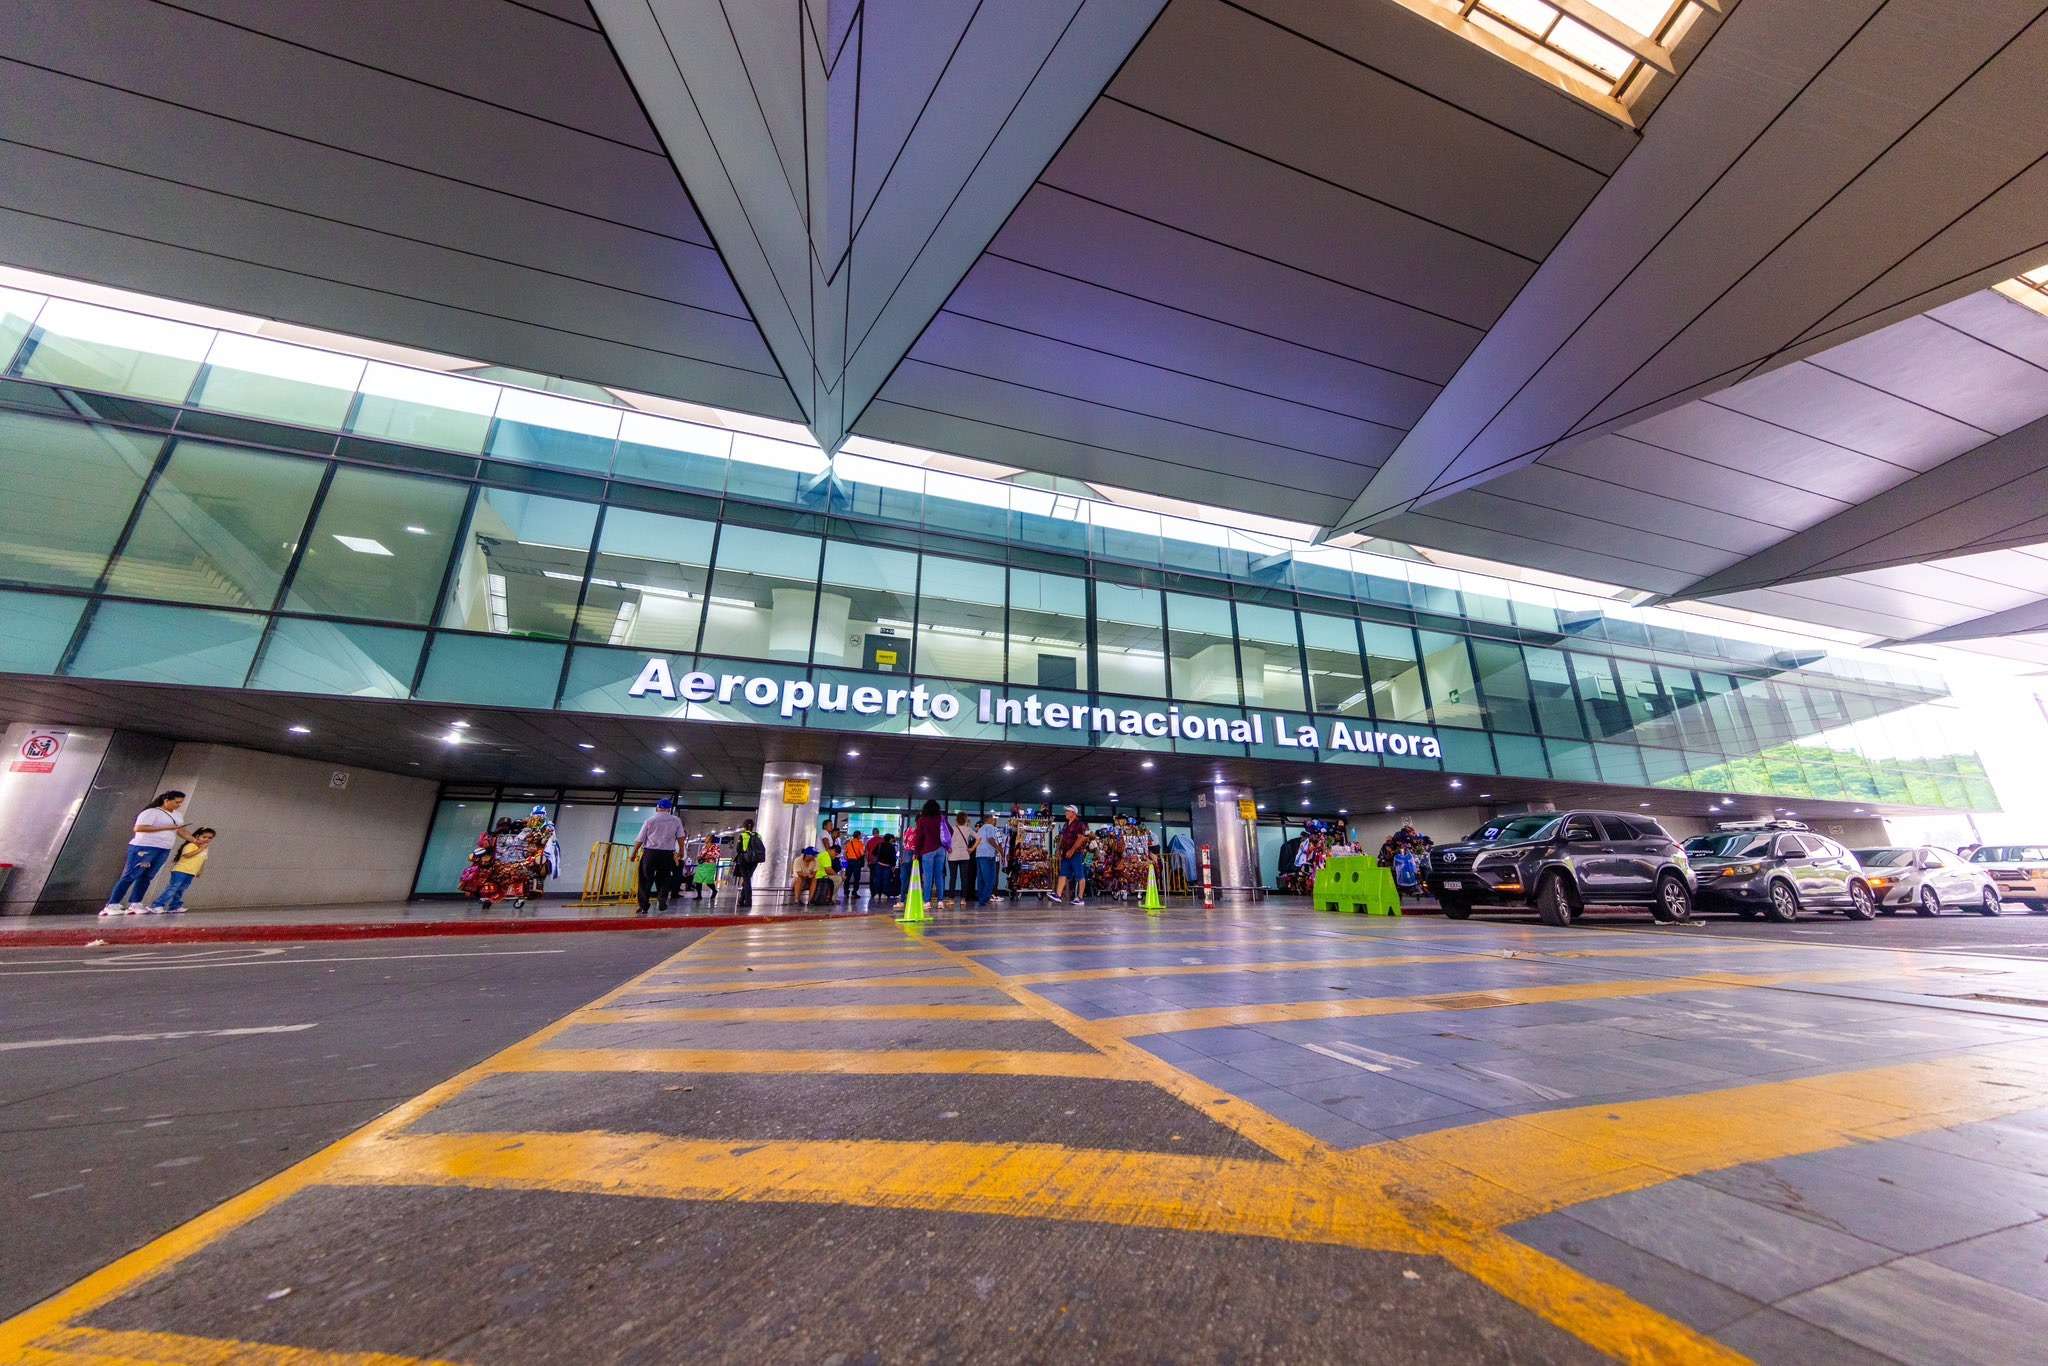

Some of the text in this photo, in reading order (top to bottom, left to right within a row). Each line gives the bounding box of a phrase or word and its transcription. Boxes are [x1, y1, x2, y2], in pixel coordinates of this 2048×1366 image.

[628, 658, 1441, 758] Aeropuerto Internacional La Aurora
